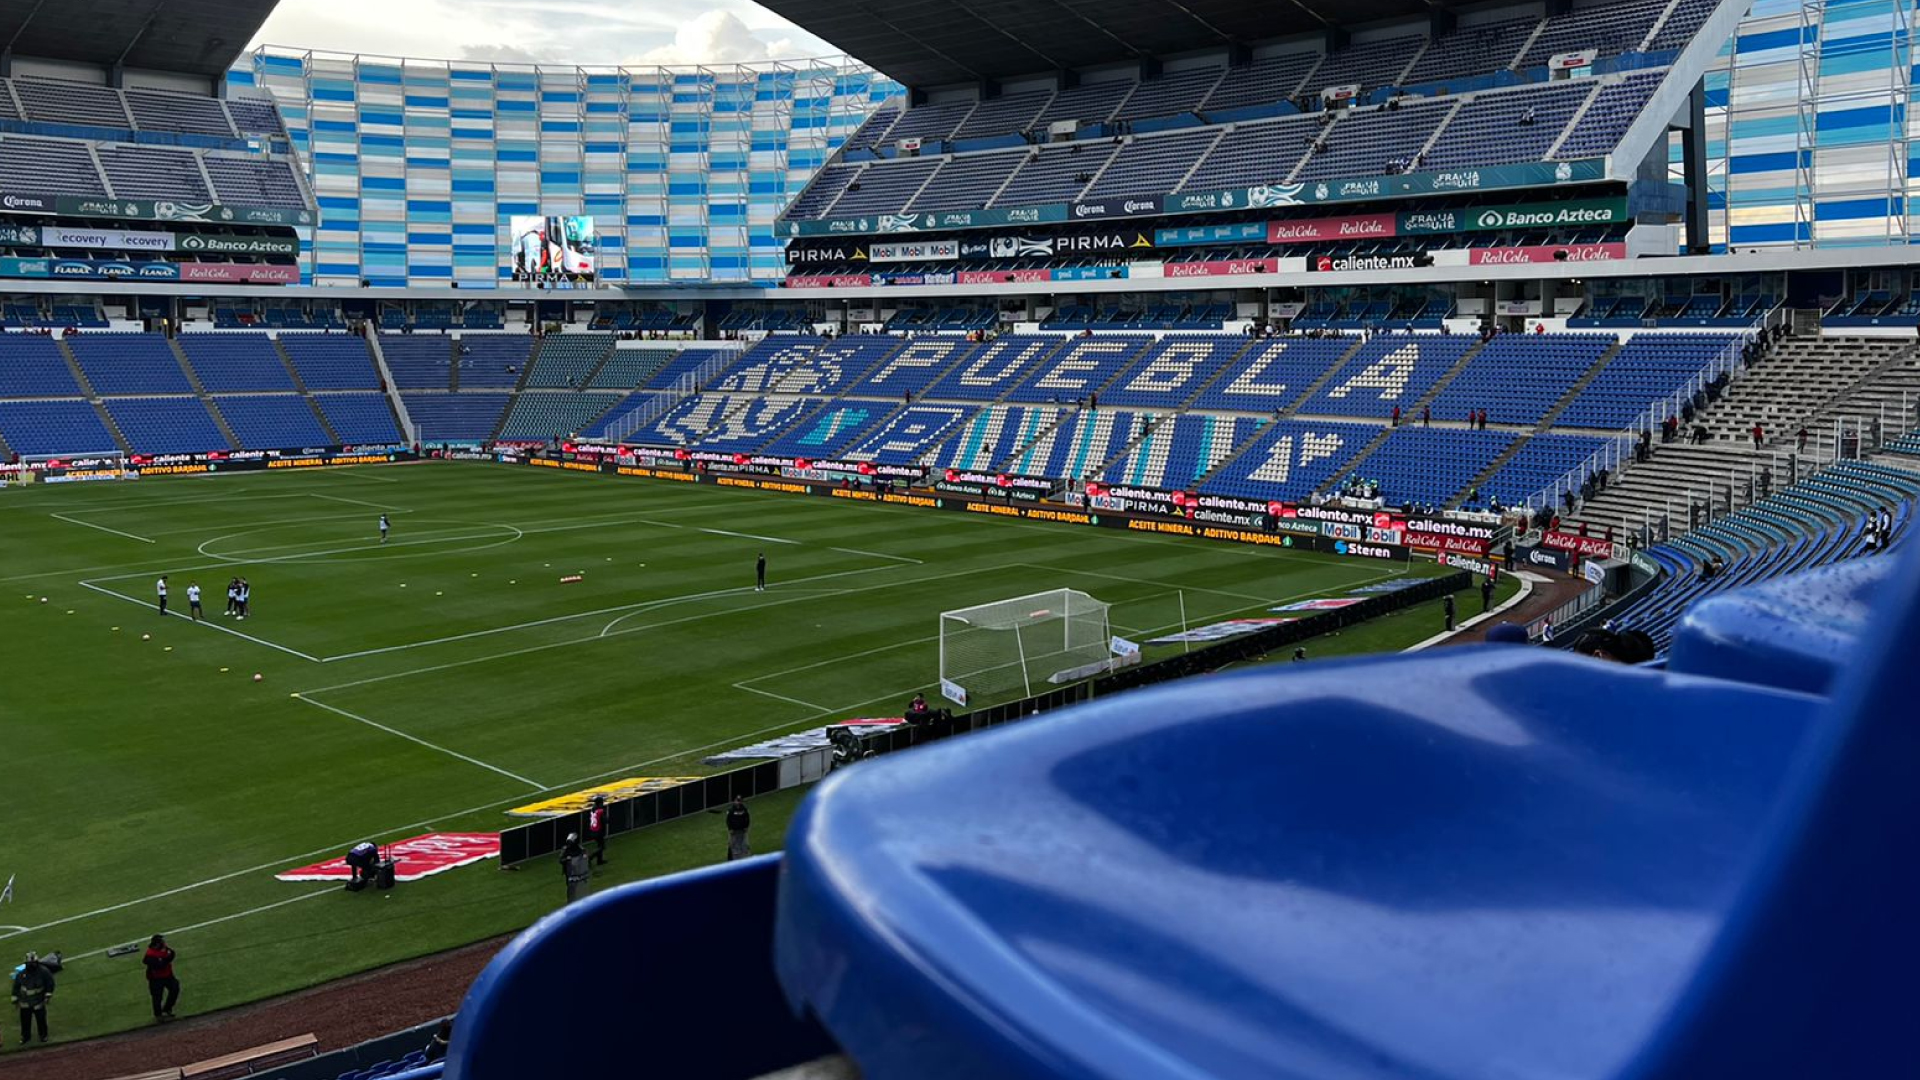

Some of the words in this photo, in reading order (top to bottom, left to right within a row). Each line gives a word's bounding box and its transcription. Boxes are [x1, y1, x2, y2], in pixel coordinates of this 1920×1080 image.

[4, 195, 43, 208] Corona
[1124, 199, 1156, 214] Corona
[1075, 204, 1107, 217] Corona
[1506, 211, 1553, 226] Banco
[1555, 208, 1612, 223] Azteca
[1277, 225, 1297, 238] Red
[1296, 224, 1317, 237] Cola
[1340, 222, 1359, 234] Red
[1359, 220, 1383, 233] Cola
[207, 239, 247, 251] Banco
[249, 241, 292, 252] Azteca
[1057, 235, 1124, 251] PIRMA
[789, 249, 846, 262] PIRMA
[872, 246, 896, 258] Mobil
[901, 245, 926, 257] Mobil
[930, 244, 955, 256] Mobil
[1481, 251, 1503, 263] Red
[1503, 249, 1529, 262] Cola
[1583, 248, 1610, 260] Cola
[54, 265, 91, 274] FLANAX
[98, 265, 132, 275] FLANAX
[1332, 256, 1414, 271] caliente.mx
[140, 266, 174, 276] FLANAX
[1172, 266, 1189, 276] Red
[1189, 265, 1208, 275] Cola
[520, 273, 568, 282] PIRMA
[870, 342, 1419, 398] PUEBLA
[229, 450, 280, 459] calientemx
[578, 445, 617, 454] caliente.mx
[634, 449, 673, 458] caliente.mx
[153, 454, 207, 462] calientemx
[692, 452, 733, 462] caliente.mx
[751, 457, 794, 466] caliente.mx
[740, 465, 770, 475] PIRMA
[812, 461, 858, 471] caliente.mx
[960, 474, 996, 484] caliente.mx
[1013, 478, 1051, 489] caliente.mx
[1110, 487, 1171, 502] caliente.mx
[1125, 501, 1168, 514] PIRMA
[1199, 497, 1267, 513] caliente.mx
[1194, 510, 1250, 525] caliente.mx
[1297, 507, 1373, 525] caliente.mx
[1128, 519, 1156, 531] ACEITE
[1158, 522, 1194, 534] MINERAL
[1204, 528, 1239, 540] ADITIVO
[1240, 532, 1281, 545] BARDAHL
[1290, 522, 1317, 532] Azteca
[1324, 523, 1357, 538] Mobil
[1408, 519, 1493, 539] caliente.mx
[1404, 533, 1421, 545] Red
[1421, 536, 1440, 547] Cola
[1445, 537, 1463, 550] Red
[1463, 539, 1482, 553] Cola
[1545, 534, 1560, 546] Red
[1560, 536, 1576, 549] Cola
[1348, 543, 1391, 558] Steren
[1530, 550, 1556, 565] Corona
